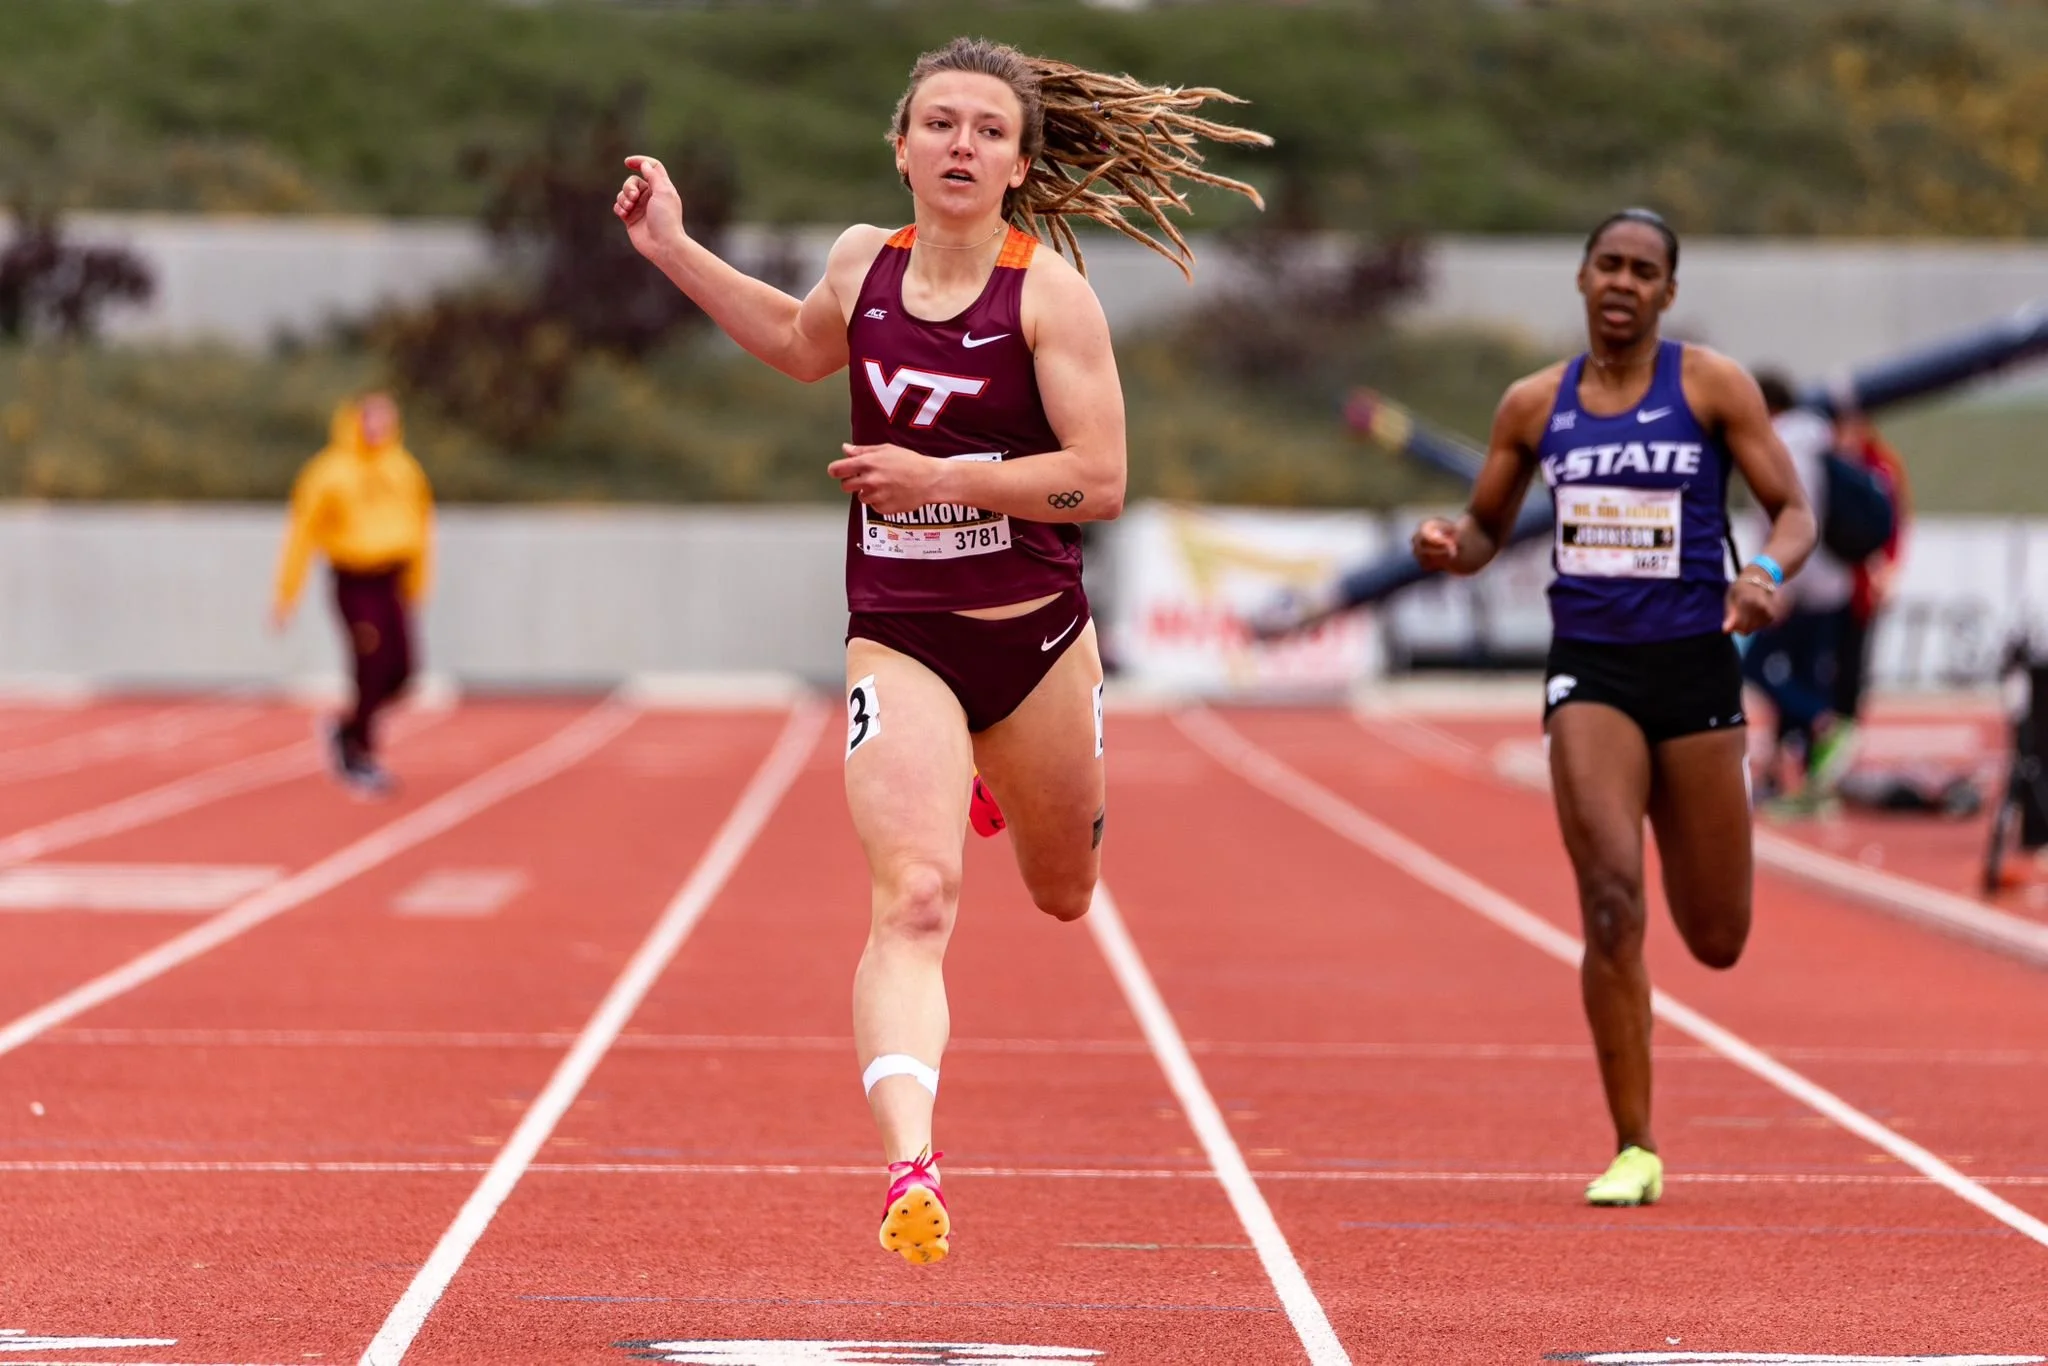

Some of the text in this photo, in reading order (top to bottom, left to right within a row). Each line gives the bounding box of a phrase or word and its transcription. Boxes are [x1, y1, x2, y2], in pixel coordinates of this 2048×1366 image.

[864, 308, 888, 320] ACC
[863, 358, 990, 428] VT
[955, 526, 999, 550] 3781
[850, 687, 870, 750] 3
